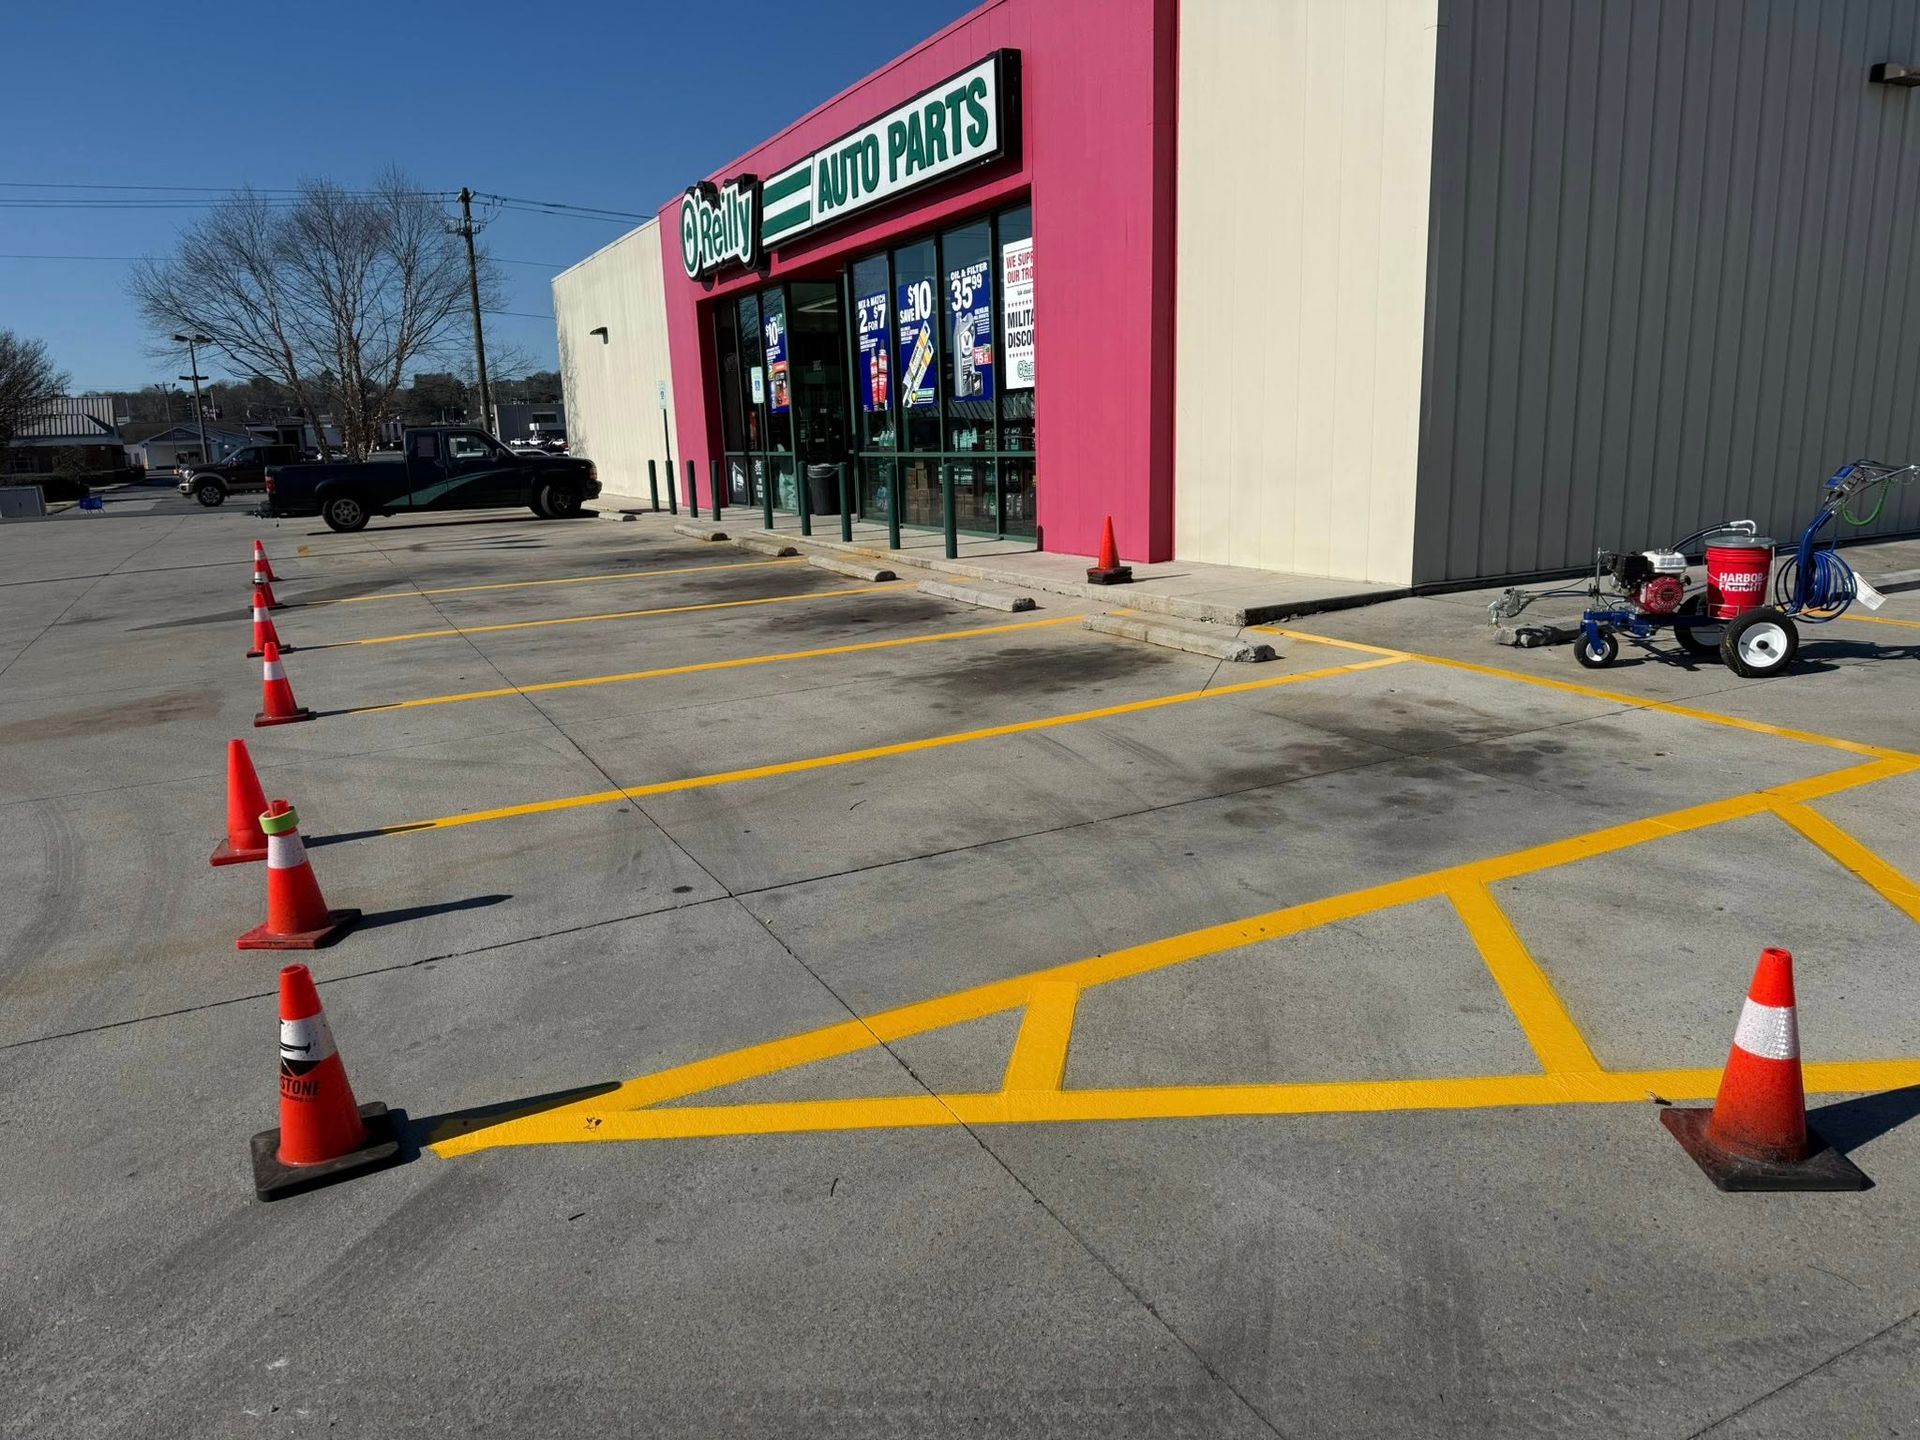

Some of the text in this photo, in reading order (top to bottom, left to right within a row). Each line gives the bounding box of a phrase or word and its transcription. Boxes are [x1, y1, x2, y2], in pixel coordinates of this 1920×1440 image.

[818, 77, 988, 213] AUTO PARTS
[681, 186, 752, 275] O'Reilly
[1006, 255, 1016, 269] WE
[950, 270, 960, 281] OIL
[967, 262, 988, 276] FILTER
[1007, 270, 1020, 284] OUR
[908, 281, 932, 320] $10
[859, 309, 868, 334] 2
[900, 308, 915, 324] SAVE
[1719, 572, 1763, 583] HARBOR
[1719, 582, 1762, 592] FREIGHT
